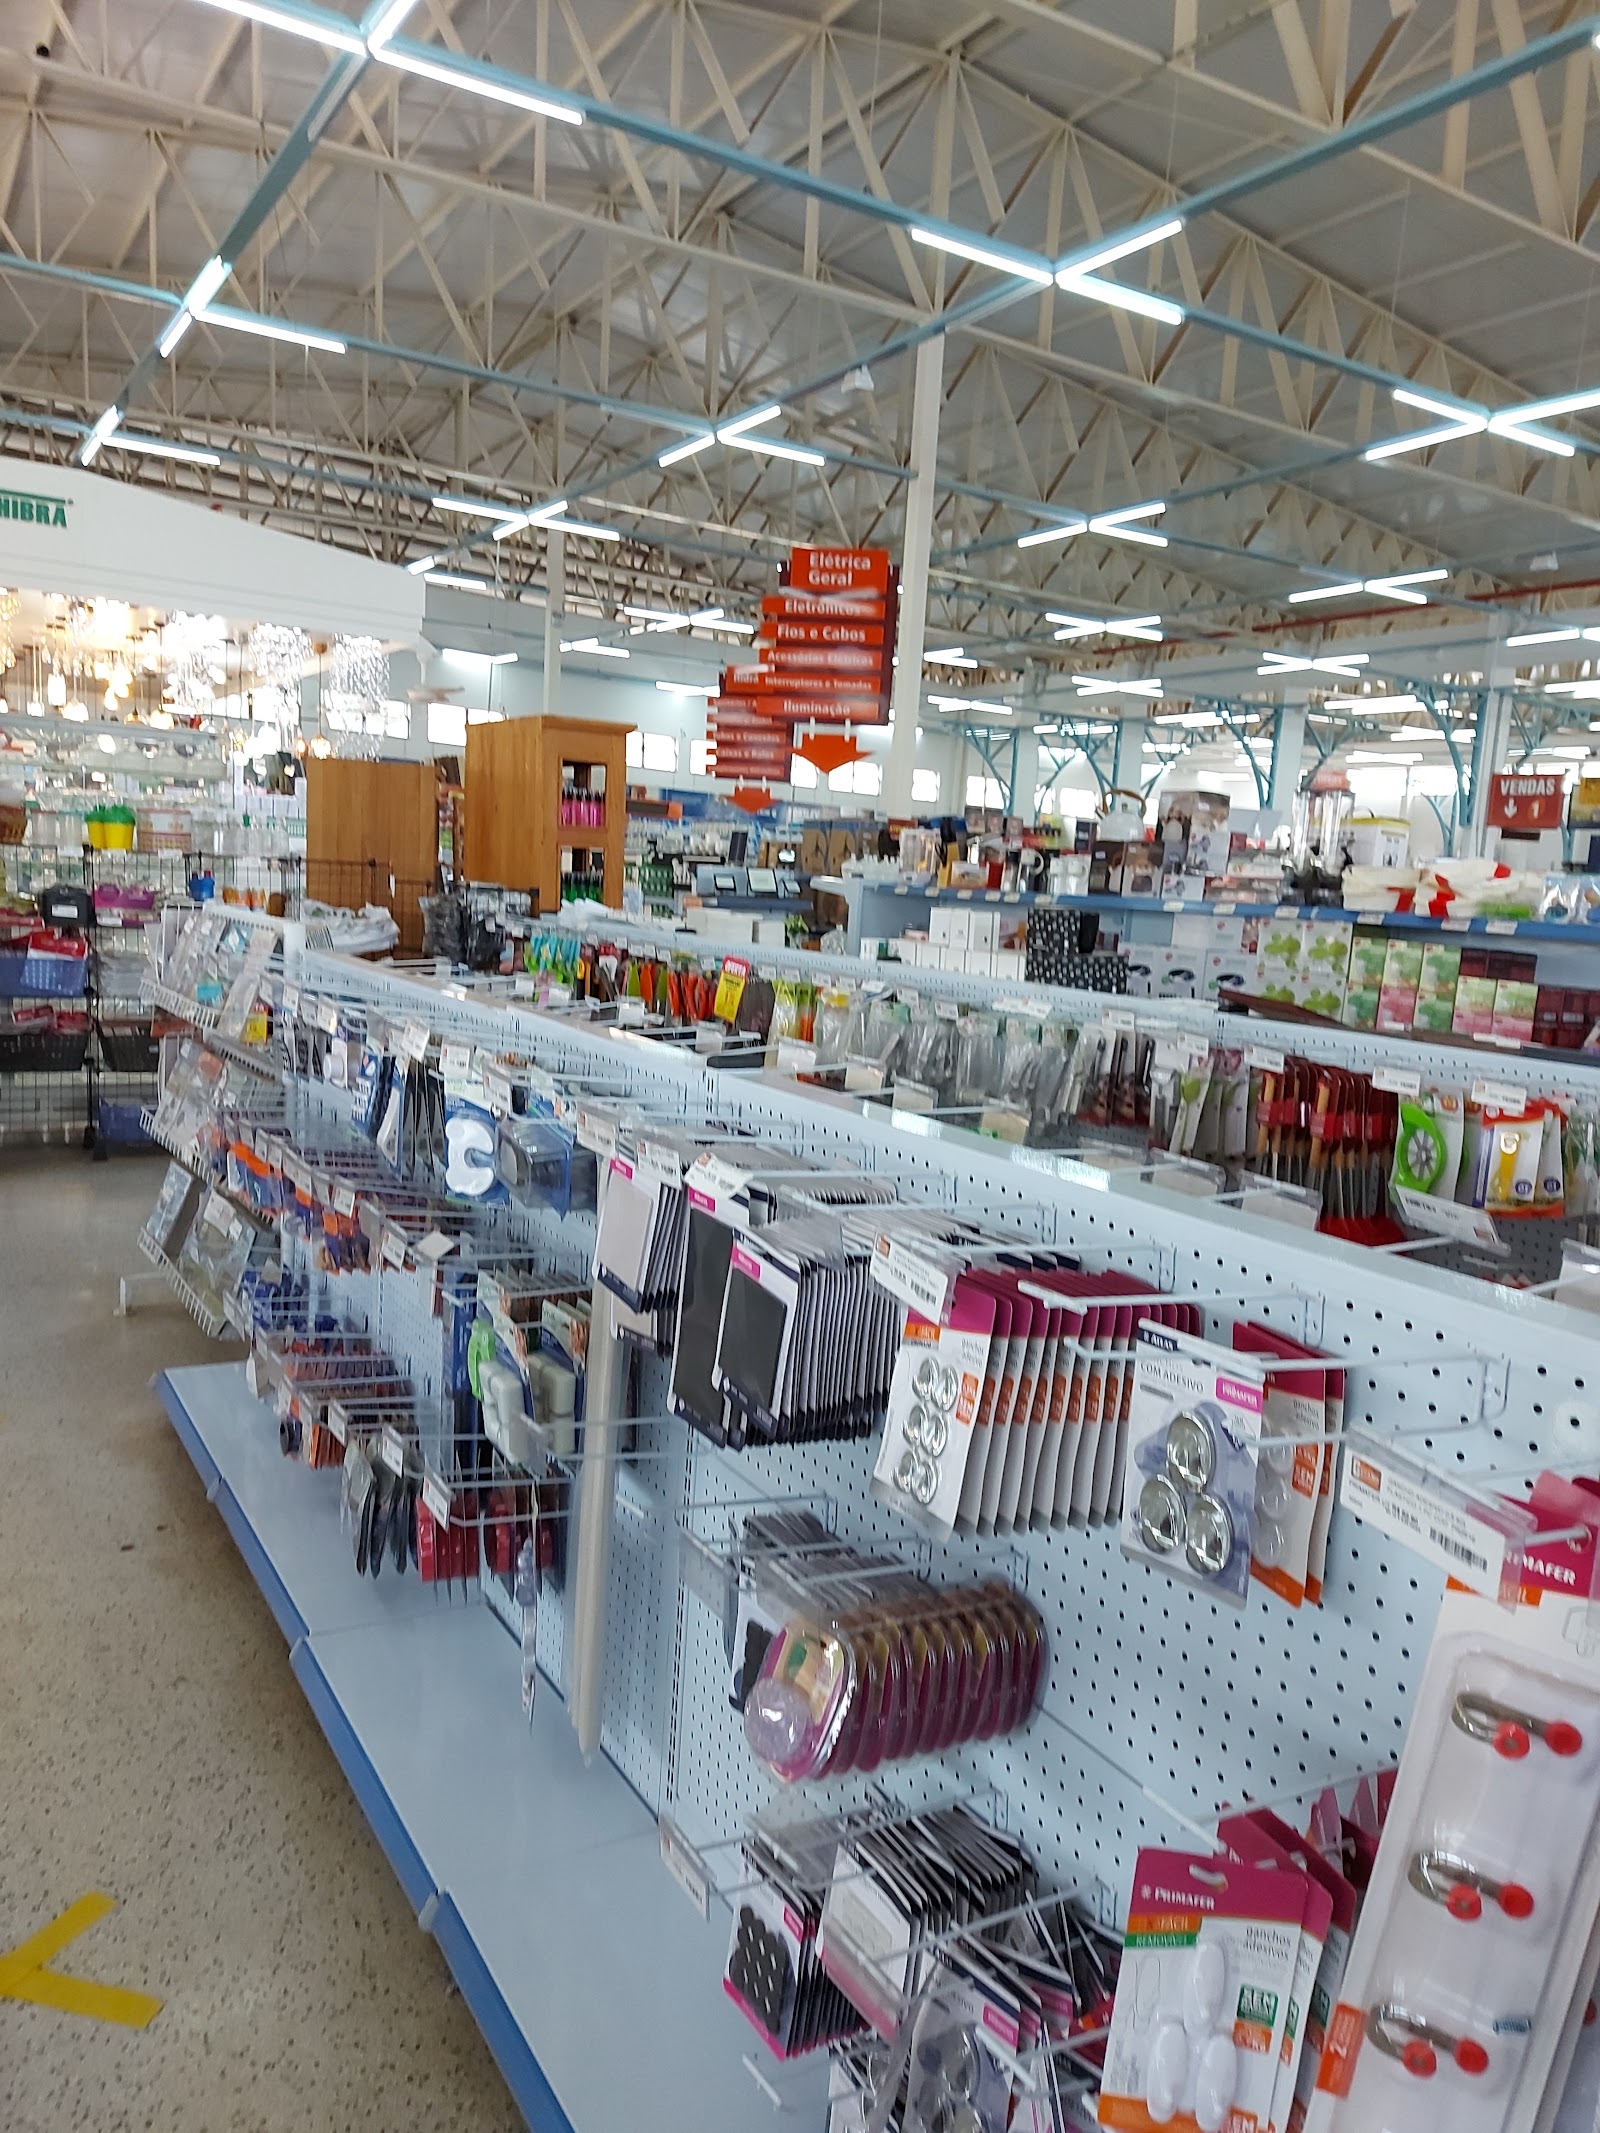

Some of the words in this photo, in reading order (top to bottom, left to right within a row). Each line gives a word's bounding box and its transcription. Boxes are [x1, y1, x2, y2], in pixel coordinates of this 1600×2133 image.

[809, 551, 871, 571] Elétrica
[808, 569, 853, 587] Geral
[778, 623, 805, 640] Fios
[809, 628, 819, 640] e
[822, 626, 866, 643] Cabos
[765, 676, 823, 689] Interruptores
[825, 680, 831, 688] e
[834, 679, 872, 690] Tomadas
[783, 699, 850, 717] Iluminação
[1501, 778, 1555, 797] VENDAS
[1532, 801, 1540, 819] 1
[1140, 1361, 1162, 1379] COM
[1163, 1369, 1204, 1394] ADESIVO
[1154, 1886, 1215, 1911] PRIMAFER
[1246, 1926, 1292, 1948] ganchos
